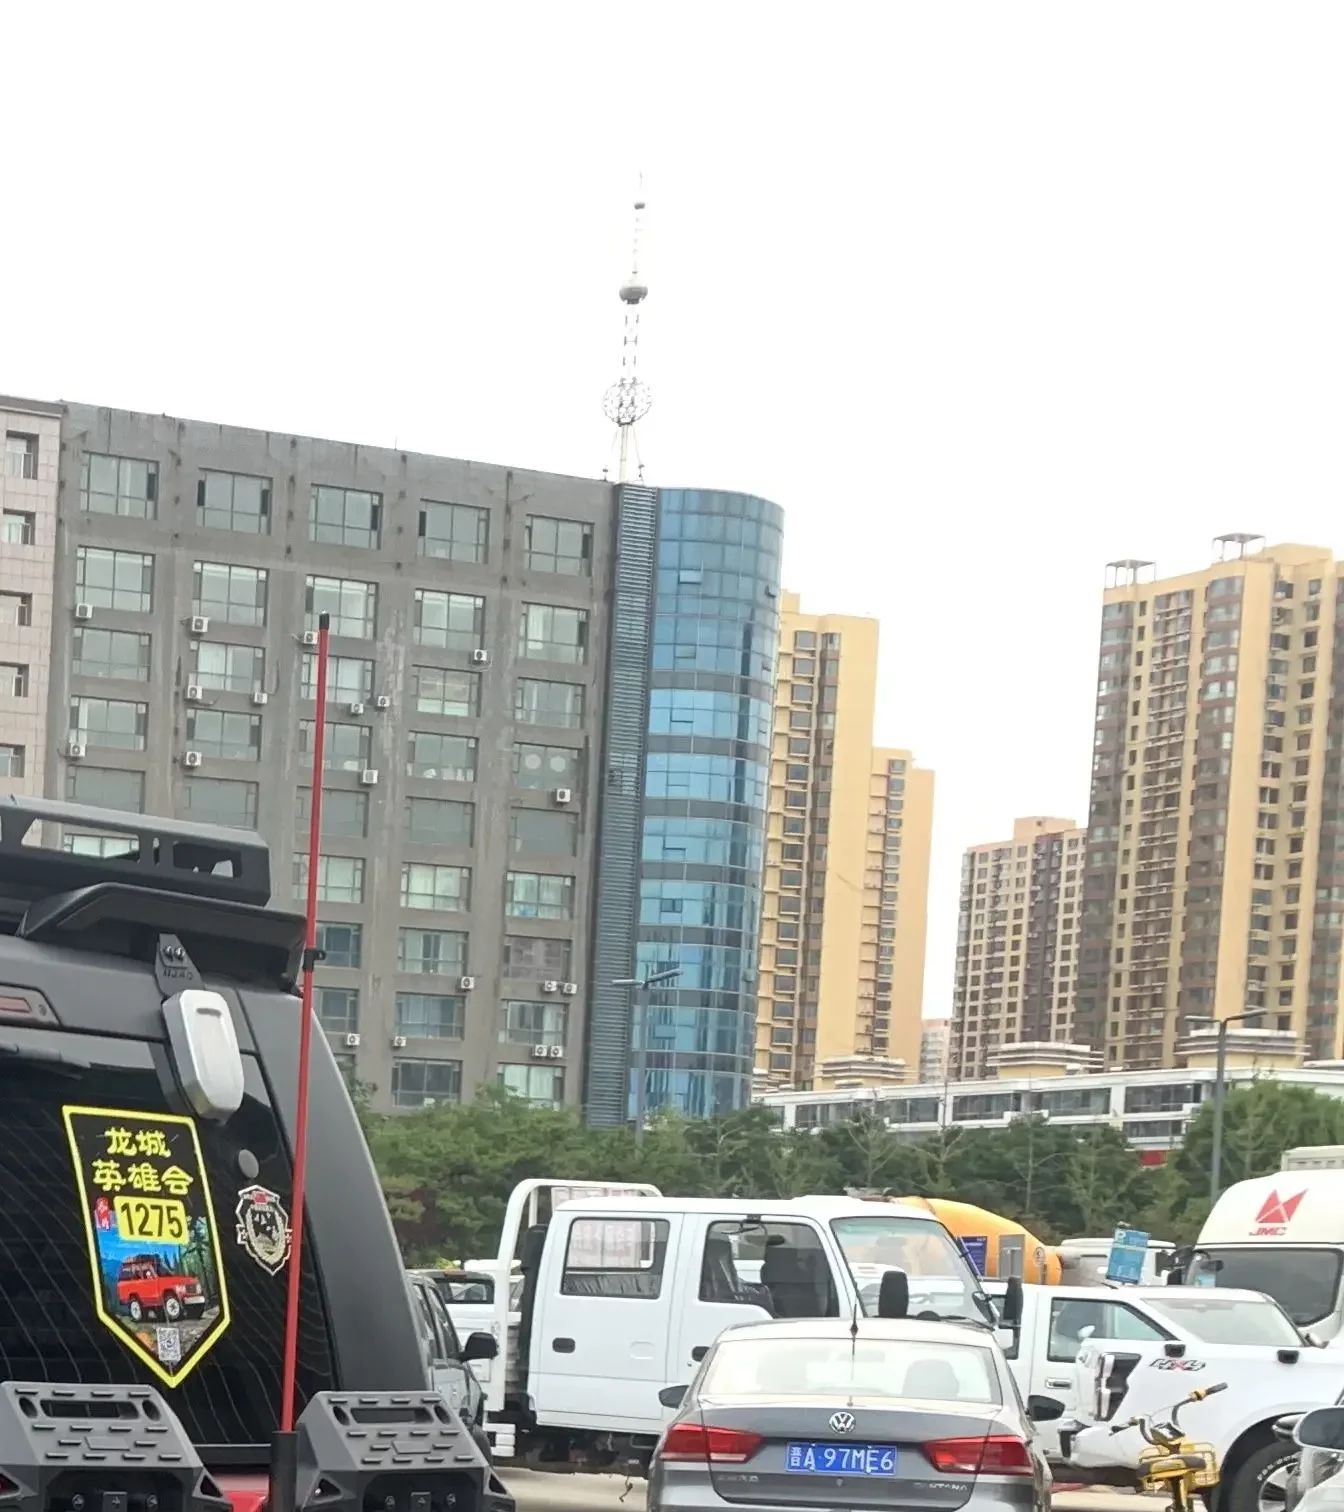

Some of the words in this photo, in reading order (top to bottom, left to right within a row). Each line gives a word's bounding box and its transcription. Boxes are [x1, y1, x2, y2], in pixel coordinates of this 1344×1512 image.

[103, 1125, 172, 1158] 龙城
[92, 1158, 194, 1195] 英雄会
[120, 1201, 184, 1239] 1275
[1248, 1226, 1287, 1236] JMC
